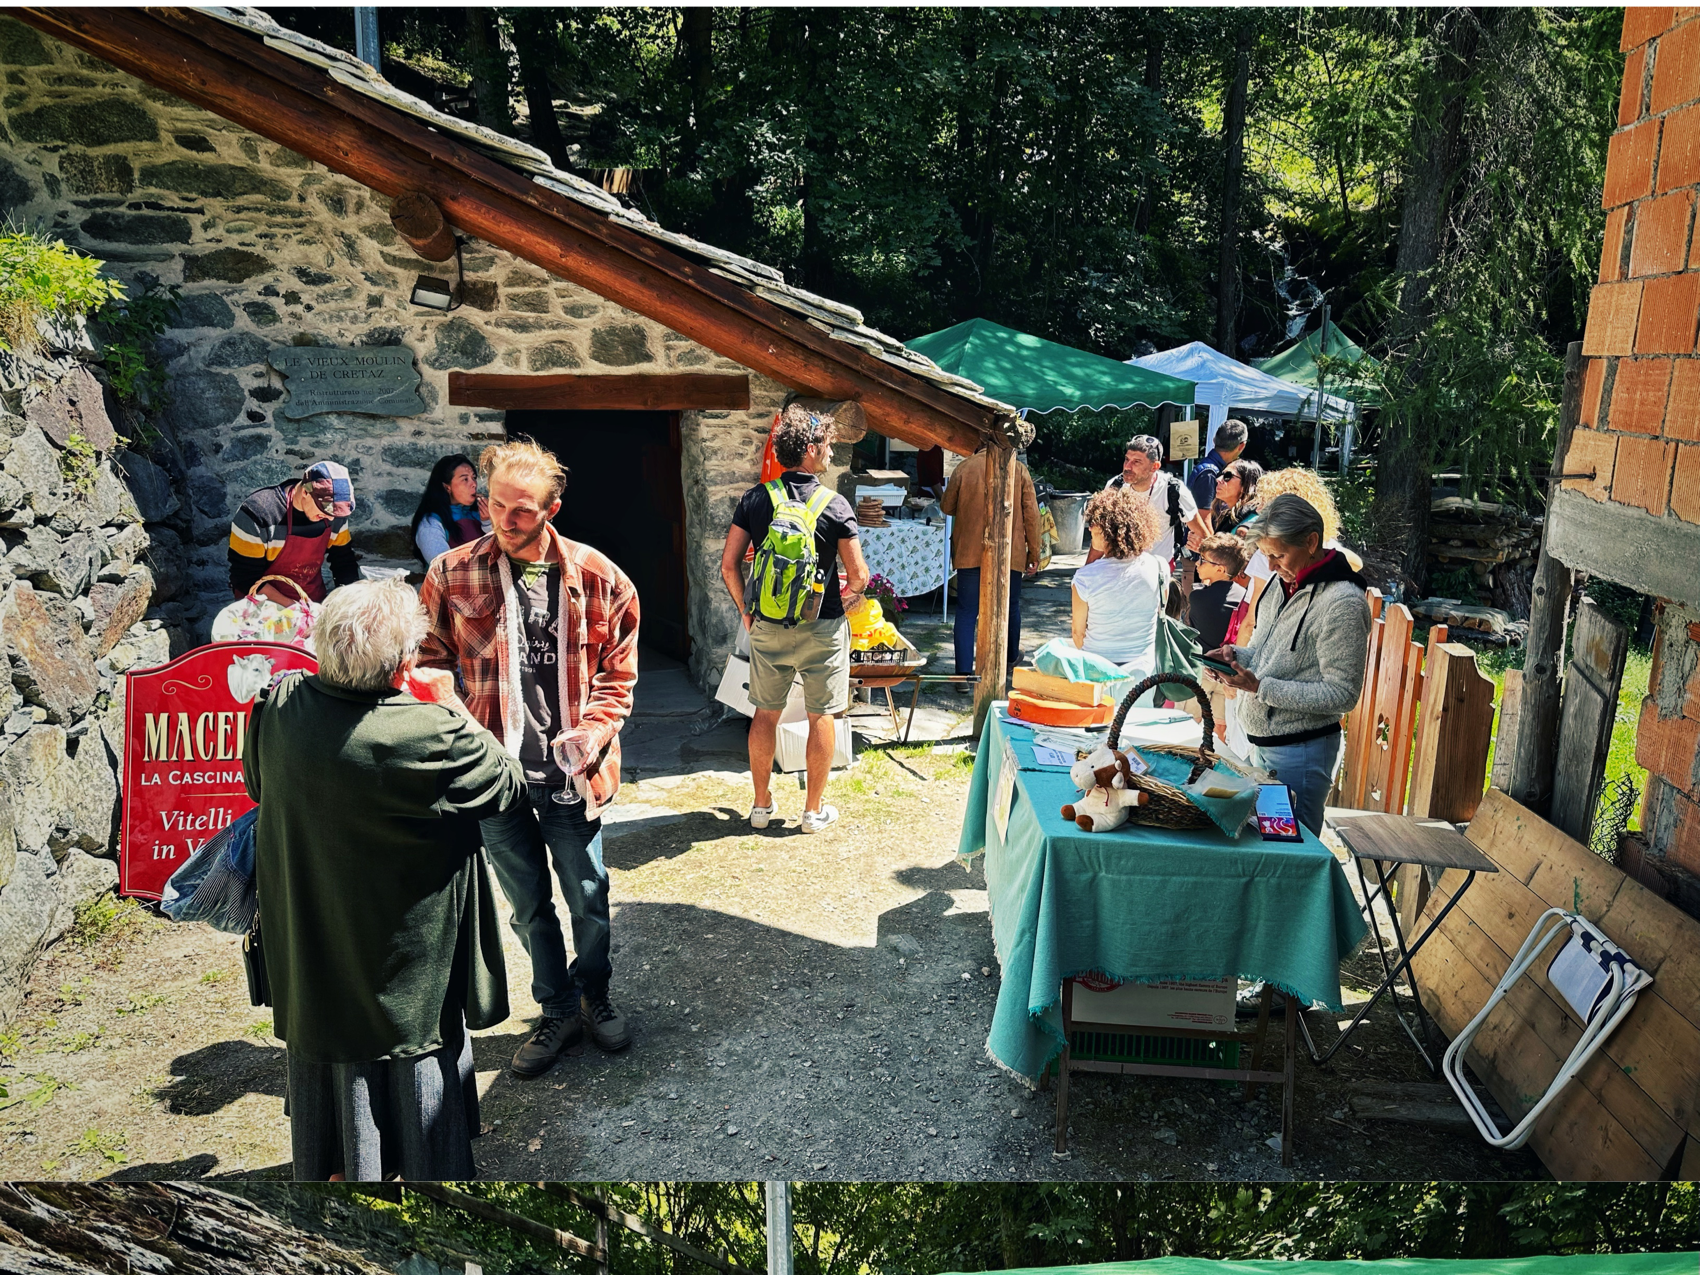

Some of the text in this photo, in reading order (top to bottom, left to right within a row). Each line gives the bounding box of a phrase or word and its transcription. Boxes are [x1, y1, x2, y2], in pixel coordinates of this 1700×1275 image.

[284, 356, 406, 367] LE VIEUX MOULIN
[310, 369, 385, 380] DE CRETAZ
[141, 770, 245, 786] LA CASCINA
[152, 840, 176, 860] in
